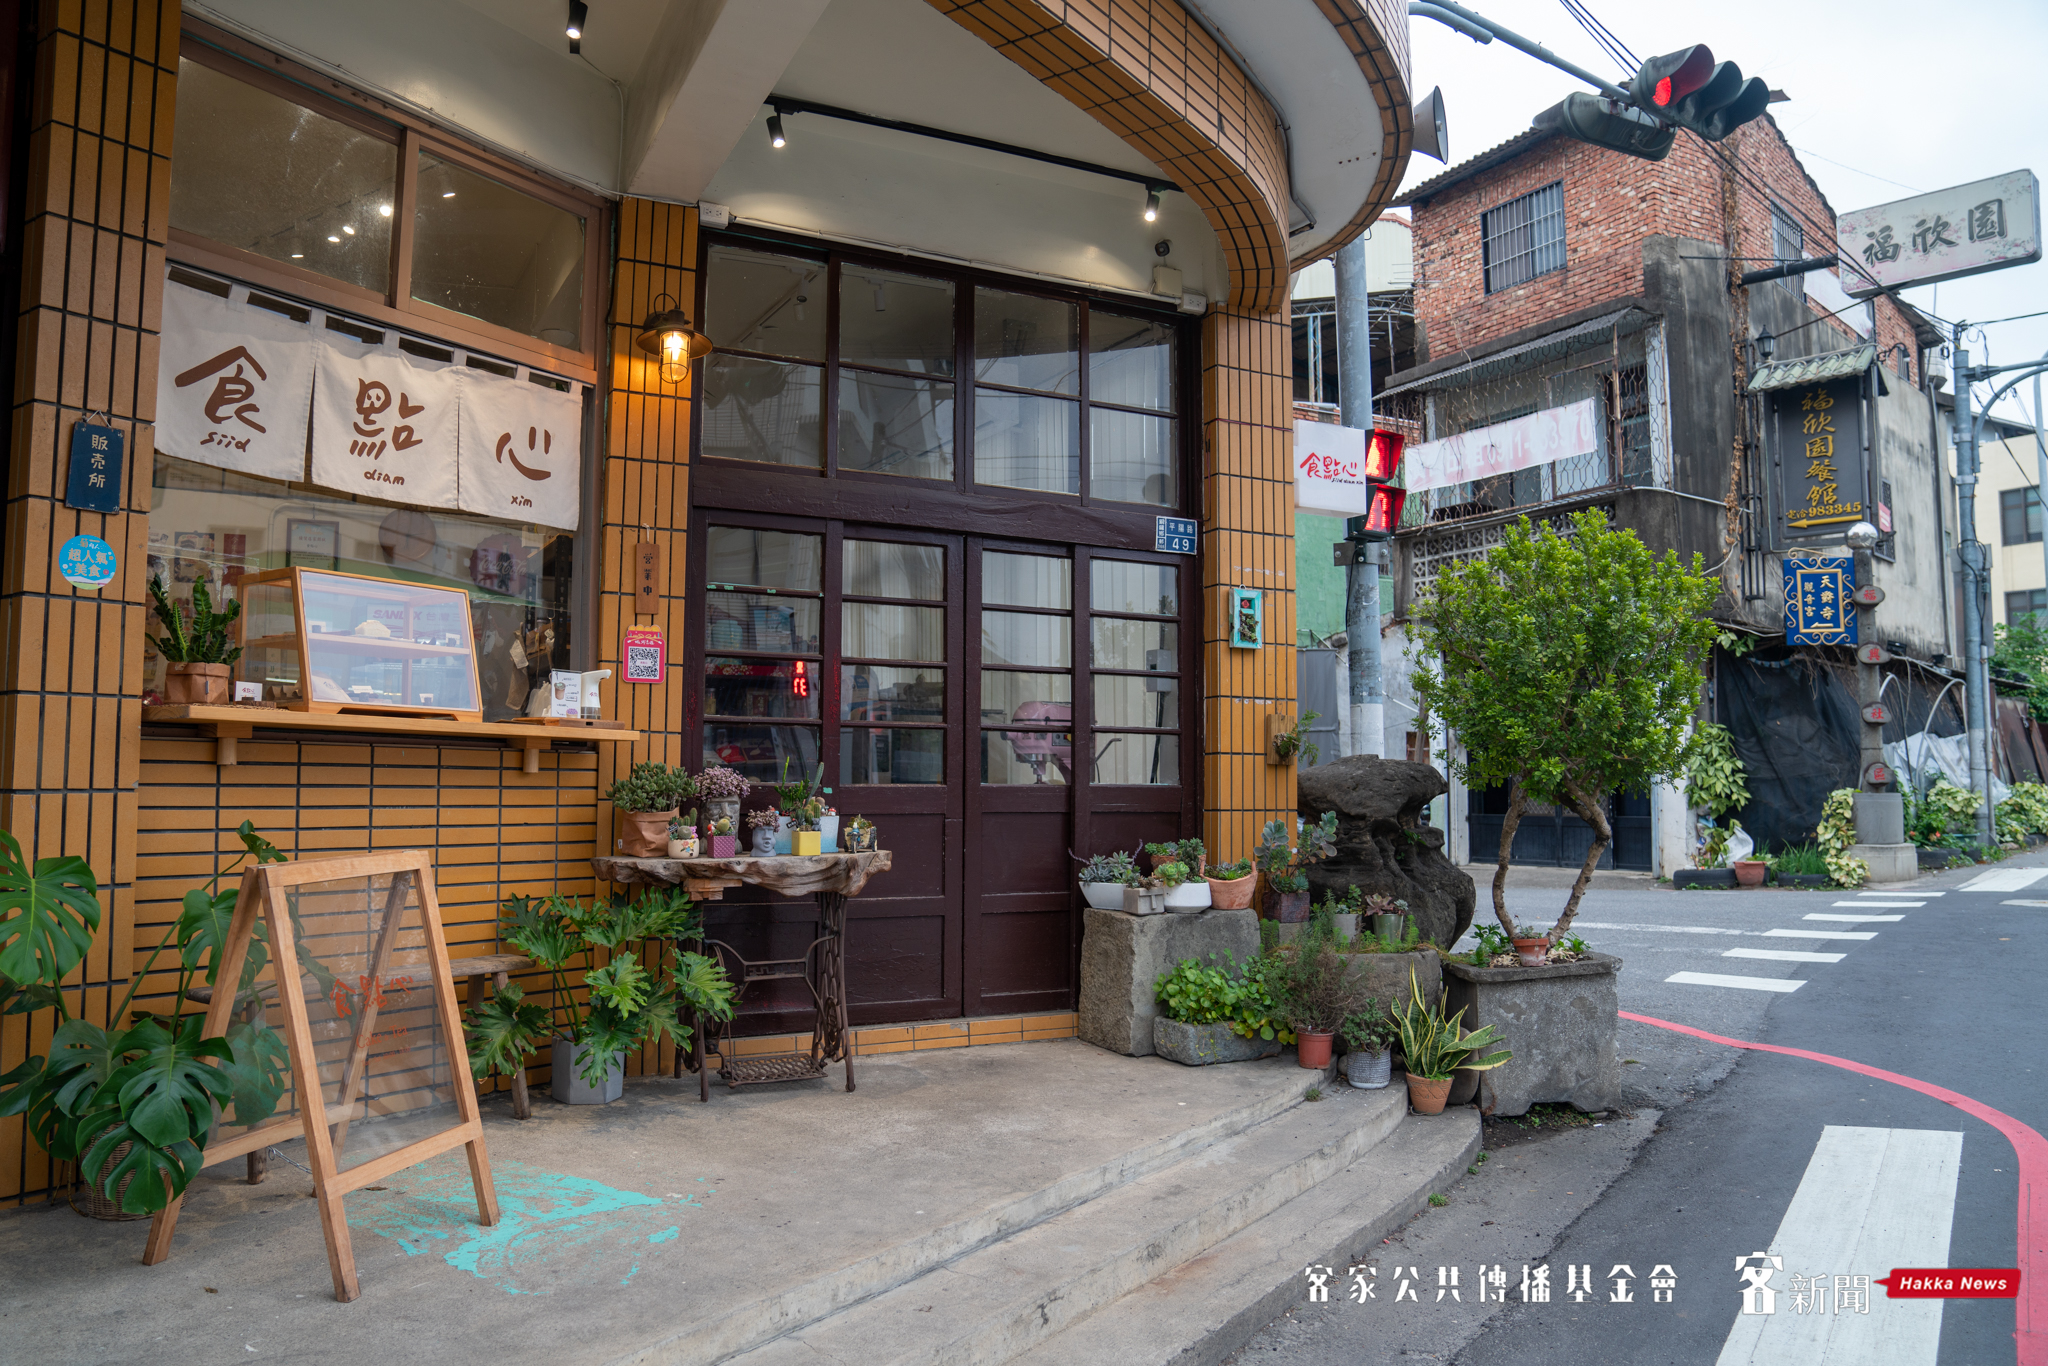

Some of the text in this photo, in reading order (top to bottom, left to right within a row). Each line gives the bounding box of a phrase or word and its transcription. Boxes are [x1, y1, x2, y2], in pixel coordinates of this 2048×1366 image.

[1862, 198, 2006, 268] 福欣園
[1801, 387, 1839, 506] 福欣園餐館
[1299, 452, 1358, 480] 食點心
[363, 468, 405, 486] diam
[510, 495, 533, 508] xim
[67, 547, 109, 565] 超人氣
[1172, 537, 1190, 551] 49
[74, 562, 102, 578] 美食
[372, 609, 423, 621] SANLX
[356, 1031, 382, 1049] Cake
[389, 1024, 408, 1038] Tea
